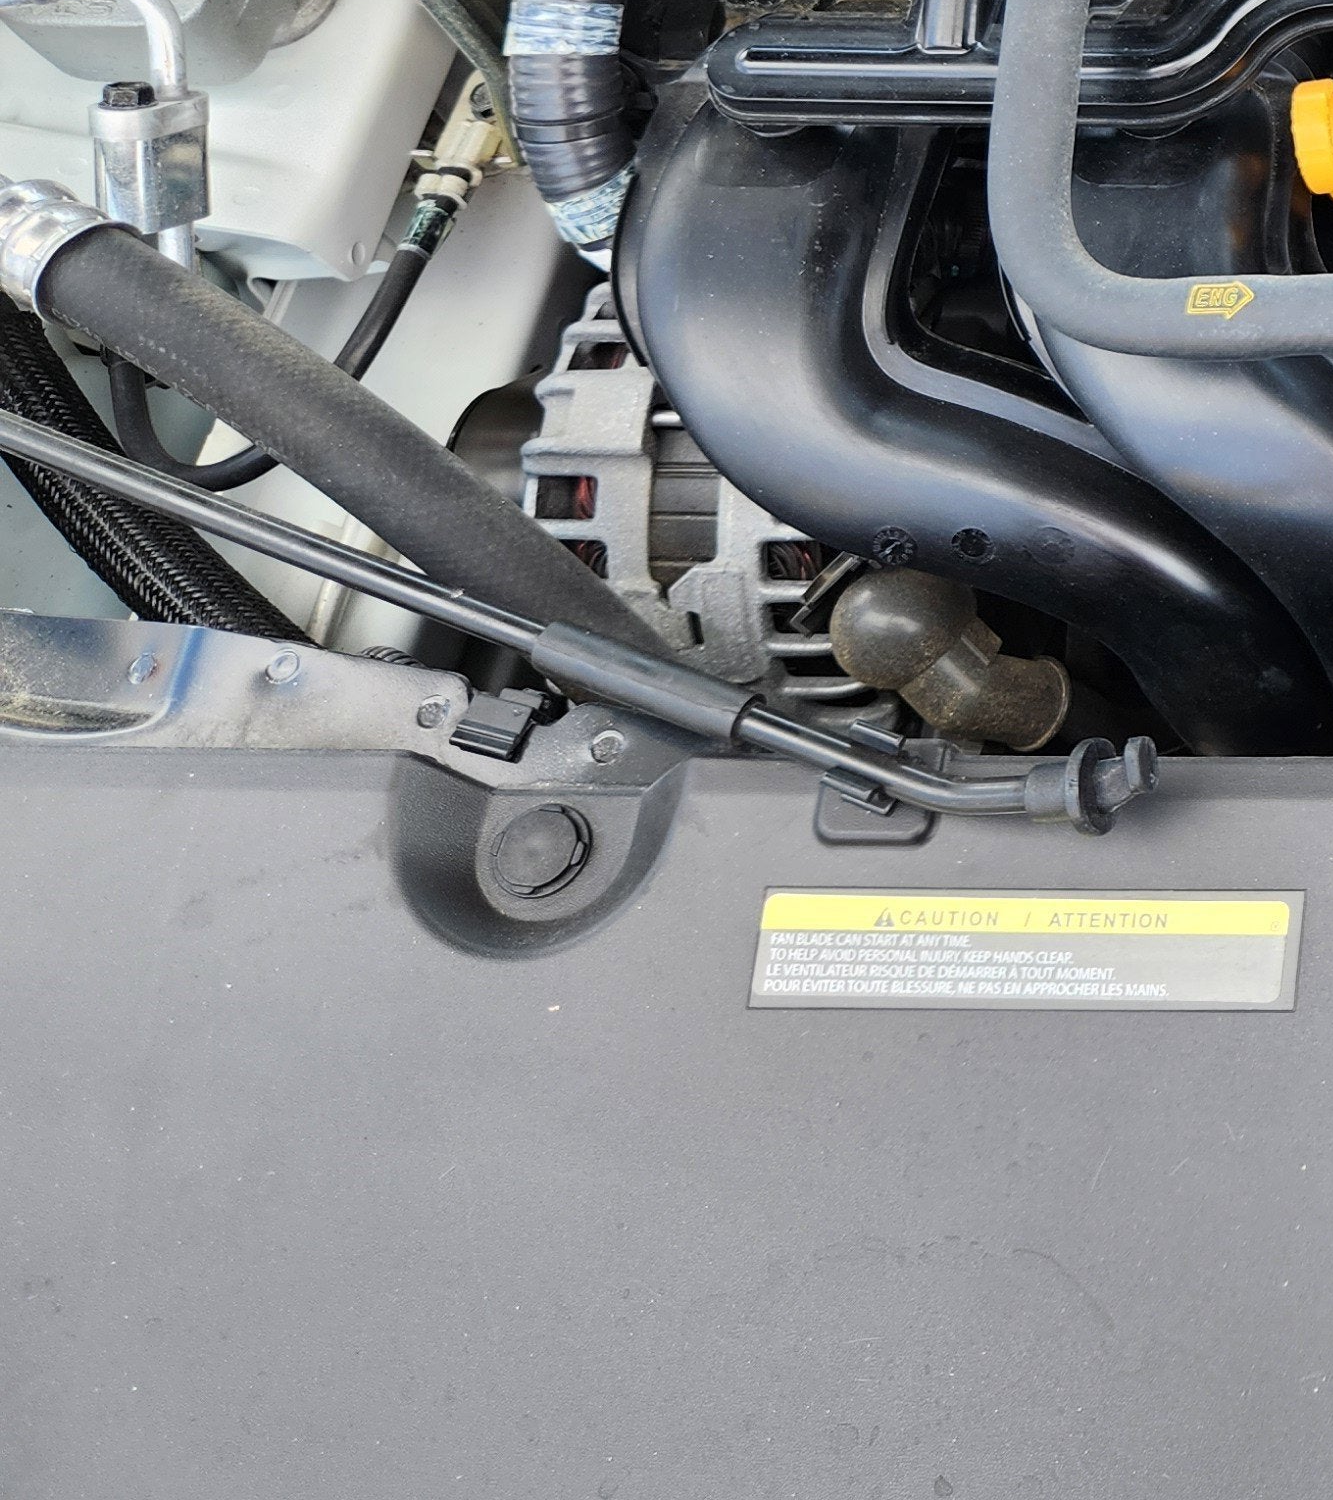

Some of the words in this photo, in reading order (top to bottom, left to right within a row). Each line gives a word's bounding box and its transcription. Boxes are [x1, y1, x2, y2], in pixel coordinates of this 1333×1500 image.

[1195, 286, 1239, 308] ENG
[899, 909, 1000, 927] CAUTION
[1048, 912, 1169, 929] ATTENTION
[770, 932, 794, 946] FAN
[796, 933, 834, 946] BLADE
[836, 933, 861, 947] CAN
[863, 933, 899, 947] START
[900, 934, 916, 947] AT
[770, 947, 787, 961] TO
[787, 948, 819, 961] HELP
[820, 948, 857, 962] AVOID
[858, 949, 918, 962] PERSONAL
[962, 950, 992, 963] KEEP
[993, 951, 1034, 964] HANDS
[766, 963, 783, 976] LE
[783, 963, 867, 977] VENTILATEUR
[868, 964, 917, 979] RISQUE
[918, 965, 937, 979] DE
[937, 964, 1007, 980] DÉMARRER
[1008, 964, 1018, 980] À
[1019, 966, 1055, 980] TOUT
[1056, 966, 1117, 981] MOMENT.
[763, 978, 800, 992] POUR
[801, 978, 846, 993] ÉVITER
[846, 980, 889, 994] TOUTE
[890, 980, 956, 996] BLESSURE,
[958, 981, 977, 995] NE
[977, 981, 1002, 995] PAS
[1002, 981, 1023, 996] EN
[1023, 982, 1100, 997] APPROCHER
[1100, 983, 1124, 997] LES
[1124, 983, 1171, 998] MAINS.
